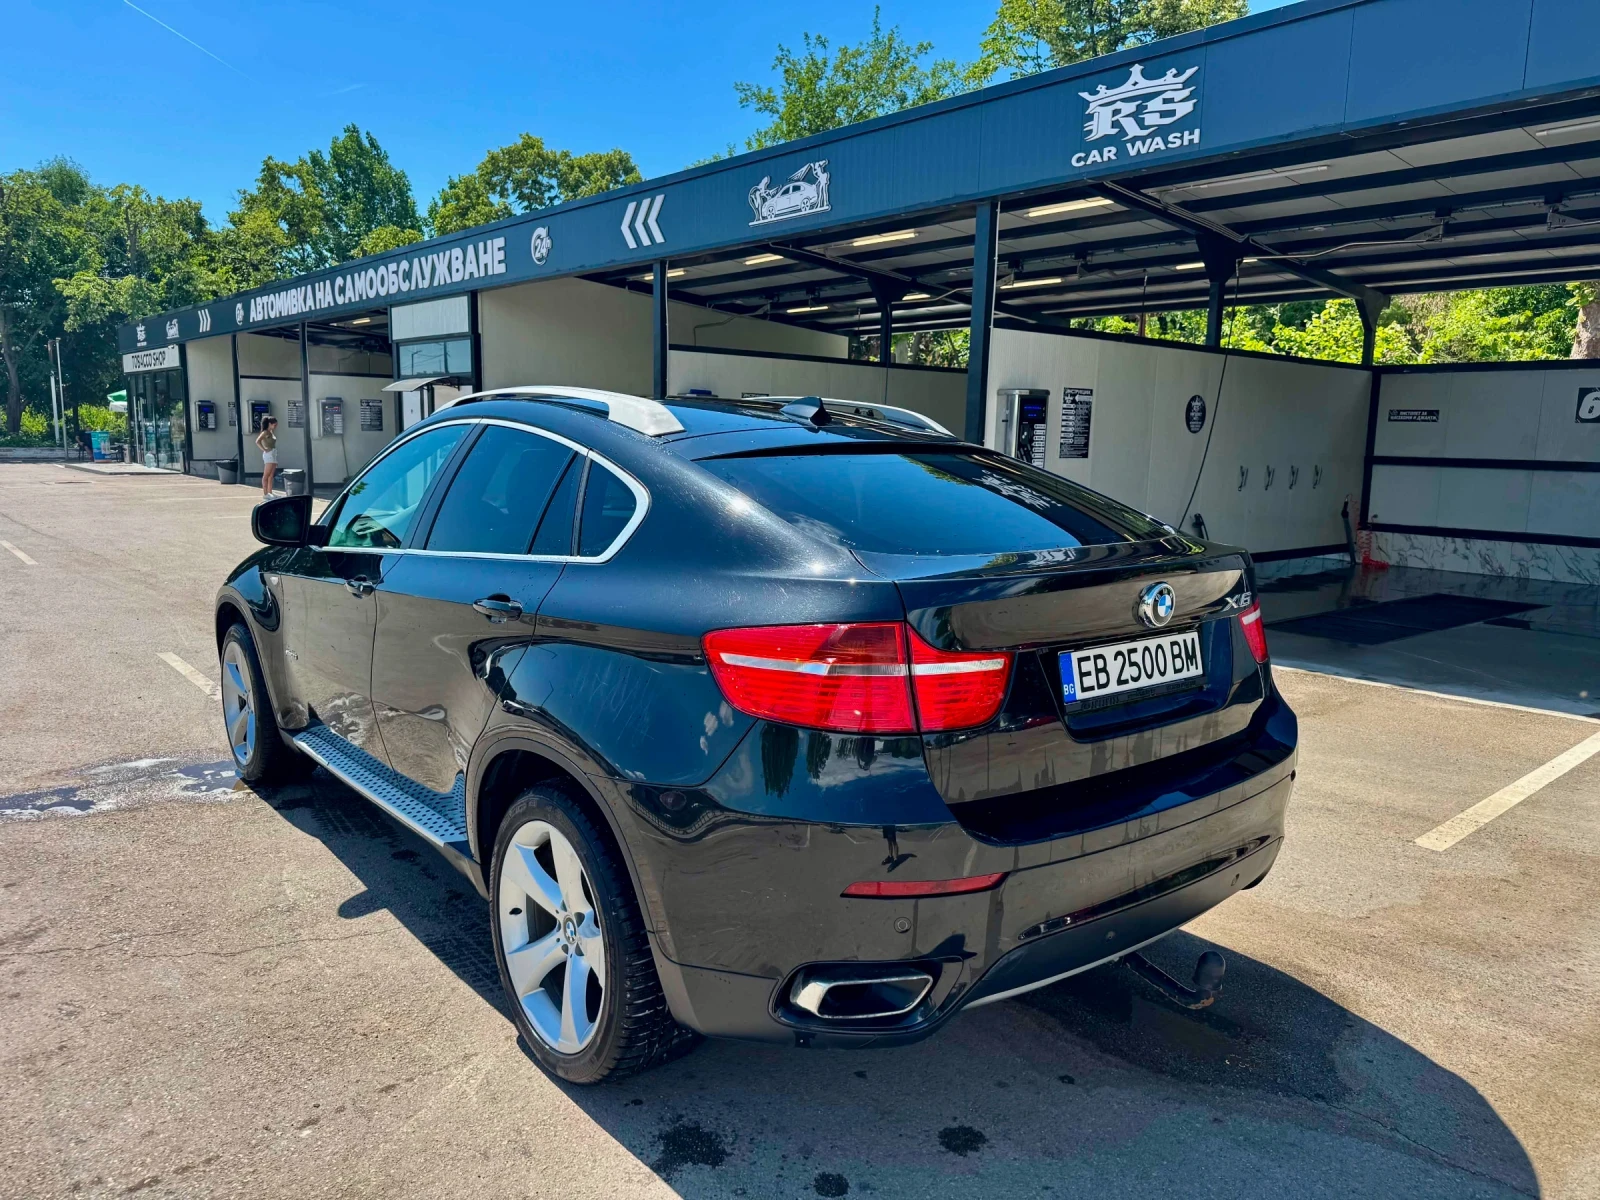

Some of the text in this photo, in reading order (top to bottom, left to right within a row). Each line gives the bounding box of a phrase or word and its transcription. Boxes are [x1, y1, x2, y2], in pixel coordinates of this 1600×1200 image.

[1084, 86, 1198, 142] RS
[1071, 128, 1200, 167] CAR WASH
[250, 237, 507, 322] АВТОМИВКА НА САМООБСЛУЖВАНЕ
[132, 351, 166, 369] TOBACCO SHOP
[1221, 591, 1252, 612] X6
[1077, 637, 1199, 693] EB 2500 BM
[1063, 683, 1075, 695] BG
